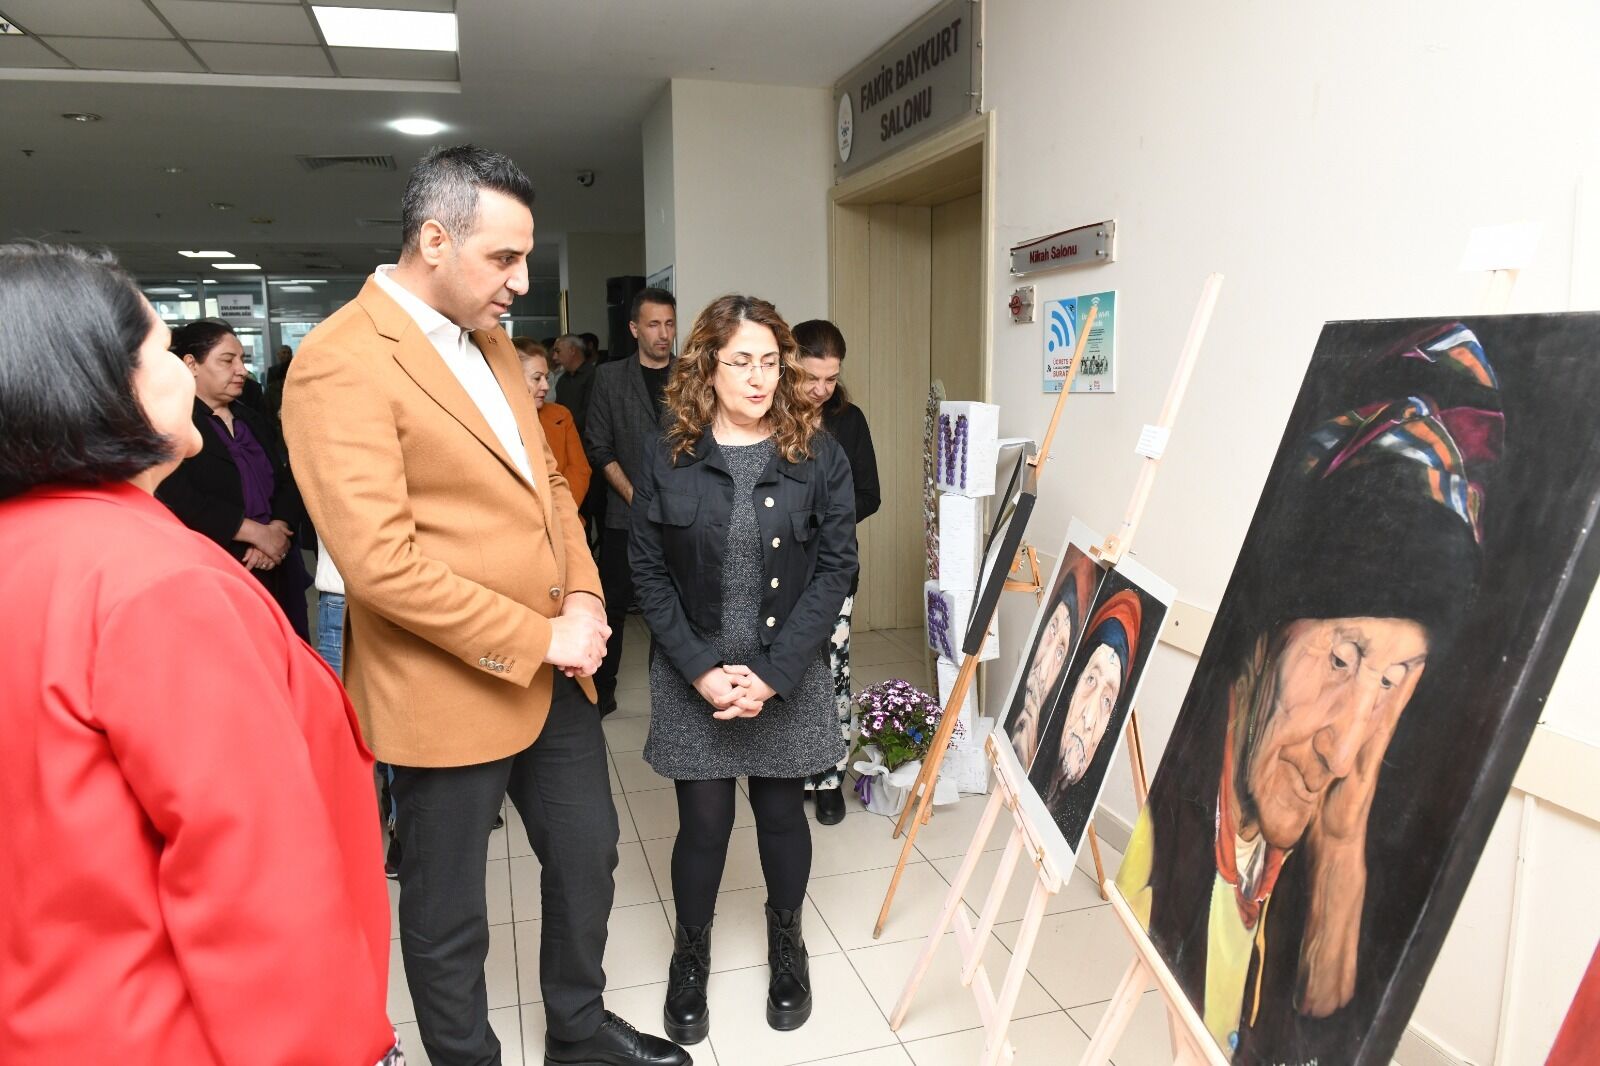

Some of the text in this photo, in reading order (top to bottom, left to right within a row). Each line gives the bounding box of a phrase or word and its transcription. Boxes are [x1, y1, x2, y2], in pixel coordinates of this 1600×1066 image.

[861, 18, 961, 113] FAKİR BAYKURT
[881, 86, 932, 141] SALONU
[1030, 244, 1077, 264] Nikah Salonu
[936, 413, 968, 489] M
